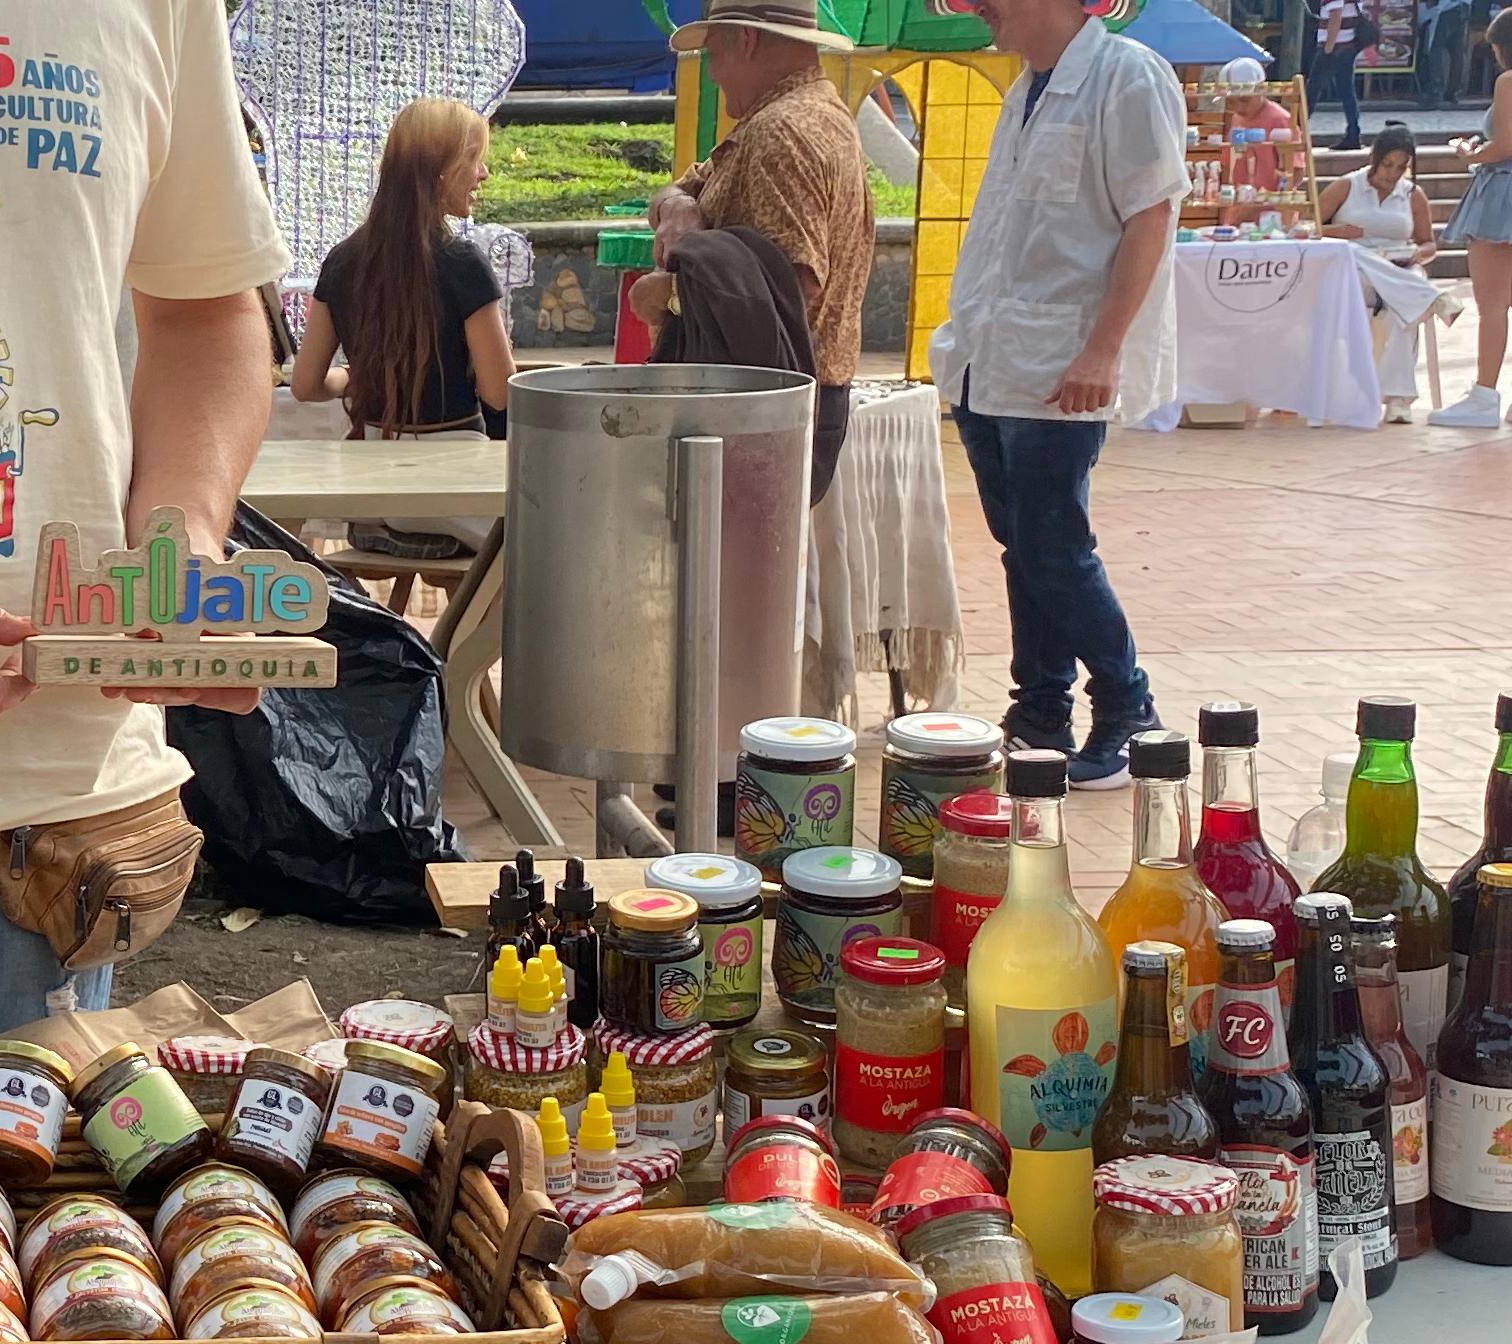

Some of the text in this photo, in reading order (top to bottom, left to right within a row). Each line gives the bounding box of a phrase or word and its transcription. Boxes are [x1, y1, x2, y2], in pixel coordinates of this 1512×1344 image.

[21, 53, 101, 99] AÑOS
[27, 128, 102, 178] PAZ
[1218, 257, 1288, 280] Darte
[64, 657, 319, 678] DE ANTIOQUIA
[1225, 1015, 1266, 1045] FC
[859, 1062, 932, 1080] MOSTAZA
[860, 1076, 932, 1091] A LA ANTIGUA
[1030, 1076, 1108, 1100] ALQUIMIA
[1239, 1171, 1267, 1189] Flor
[1265, 1256, 1288, 1270] ALE
[1255, 1275, 1292, 1290] ALCOHOL
[1247, 1288, 1301, 1306] PARA LA SALUD
[950, 1294, 1036, 1323] MOSTAZA
[968, 1317, 984, 1331] LA
